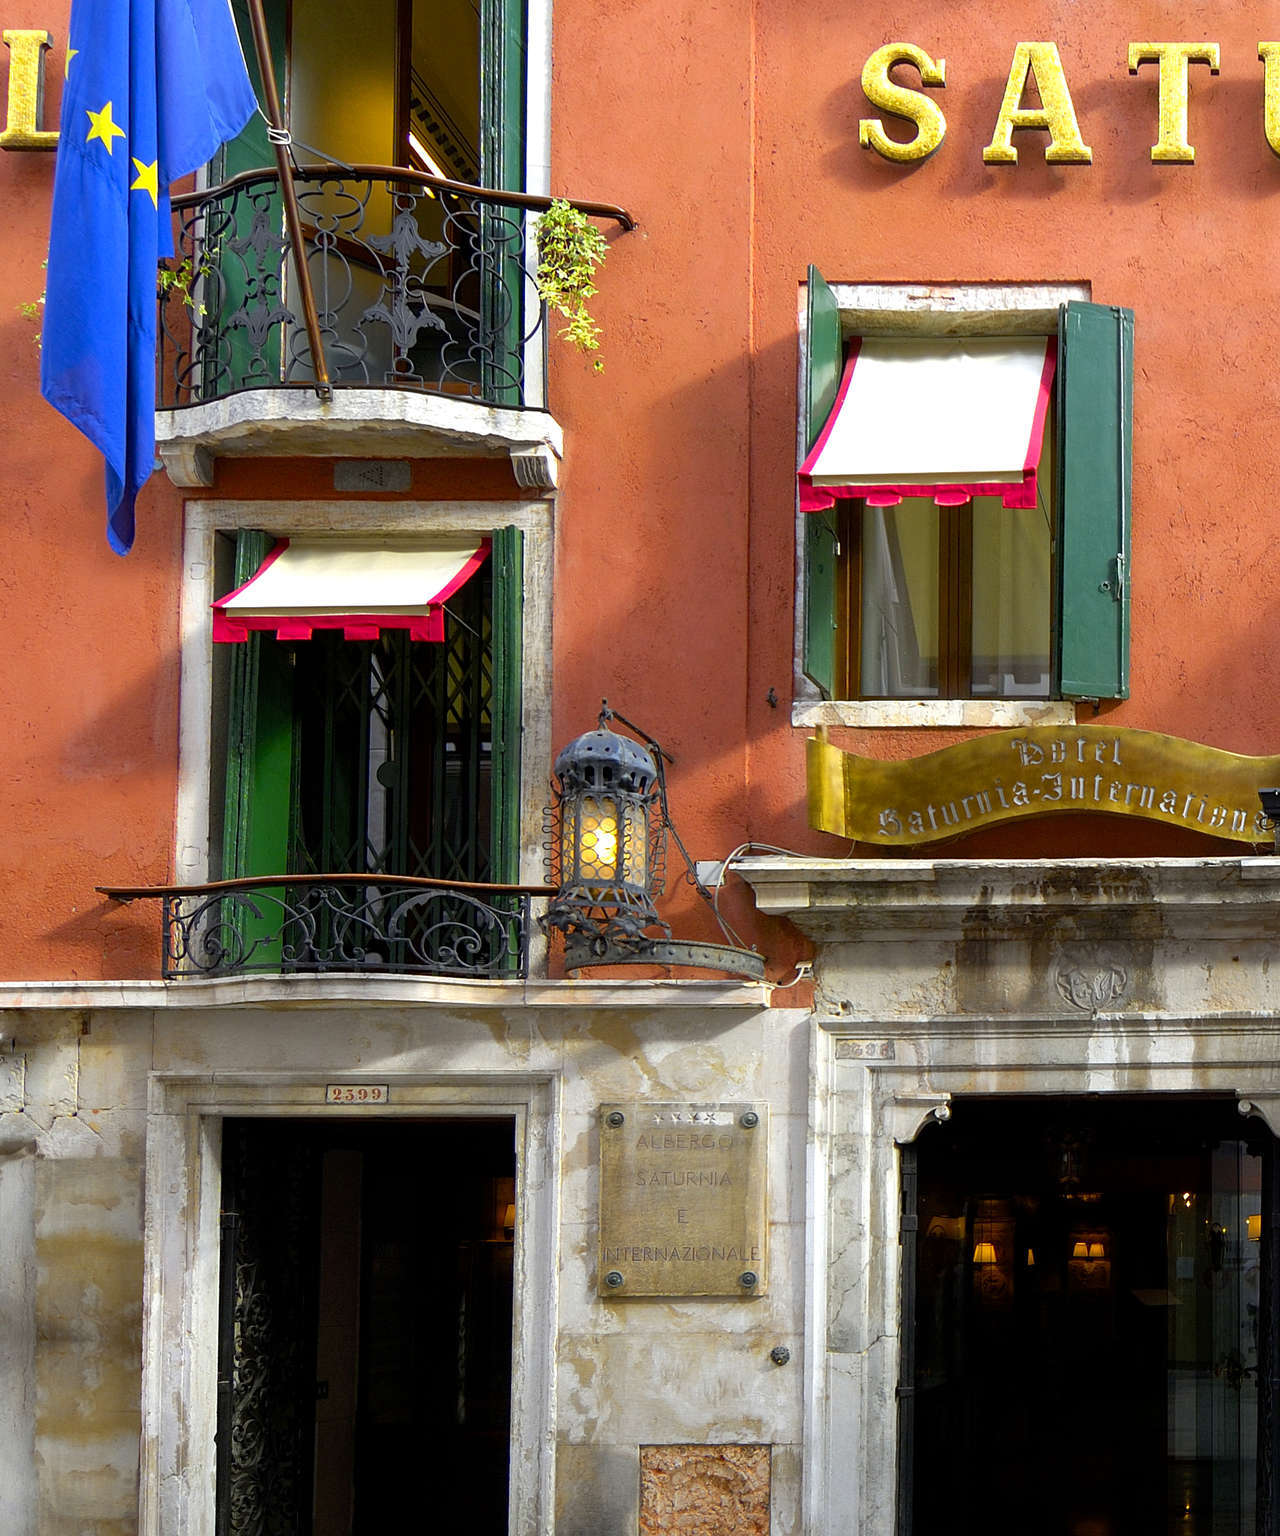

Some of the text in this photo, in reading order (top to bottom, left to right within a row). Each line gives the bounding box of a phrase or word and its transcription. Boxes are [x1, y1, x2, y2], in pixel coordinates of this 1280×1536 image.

[1011, 736, 1122, 767] Hotel
[333, 1088, 381, 1101] 2399
[636, 1134, 733, 1150] ALBERGO
[635, 1171, 732, 1186] SATURNIA
[677, 1209, 688, 1224] E
[602, 1246, 761, 1262] INTERNAZIONALE
